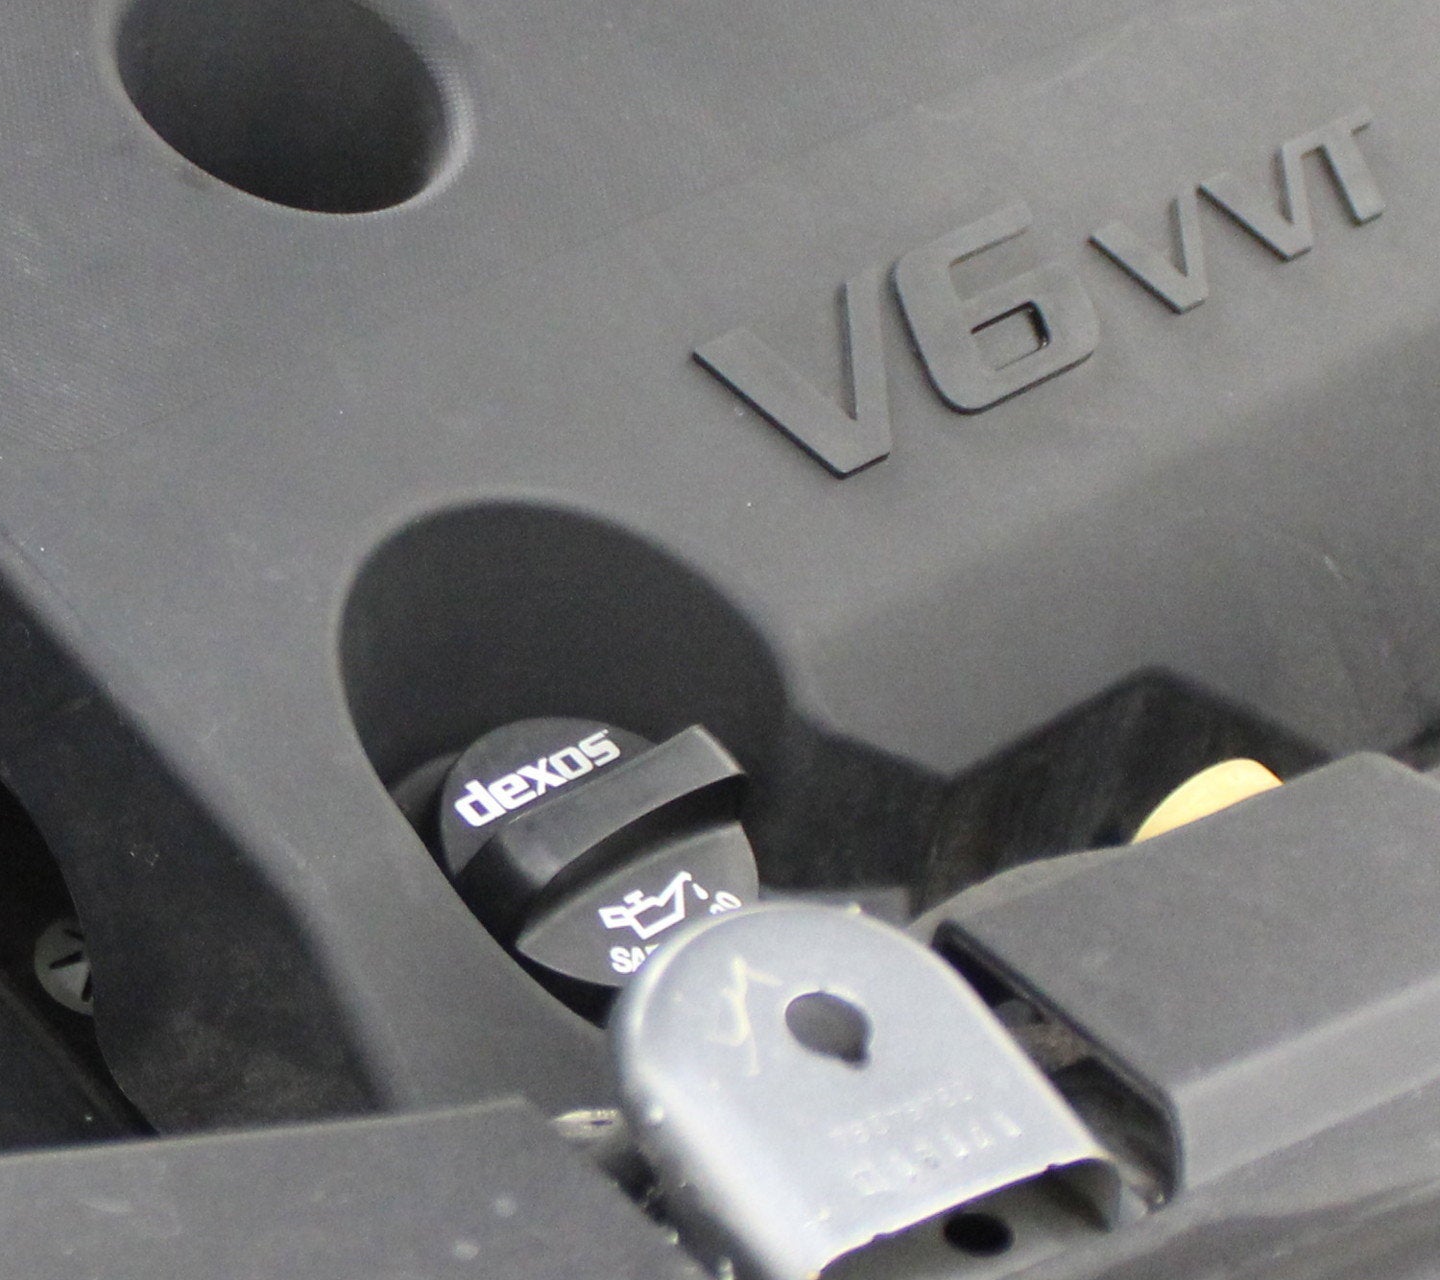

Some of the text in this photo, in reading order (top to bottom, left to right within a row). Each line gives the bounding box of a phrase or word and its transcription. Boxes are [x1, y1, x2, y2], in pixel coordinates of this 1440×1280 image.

[692, 108, 1386, 481] V6 VVT
[454, 731, 621, 827] dexos
[610, 943, 660, 974] SA
